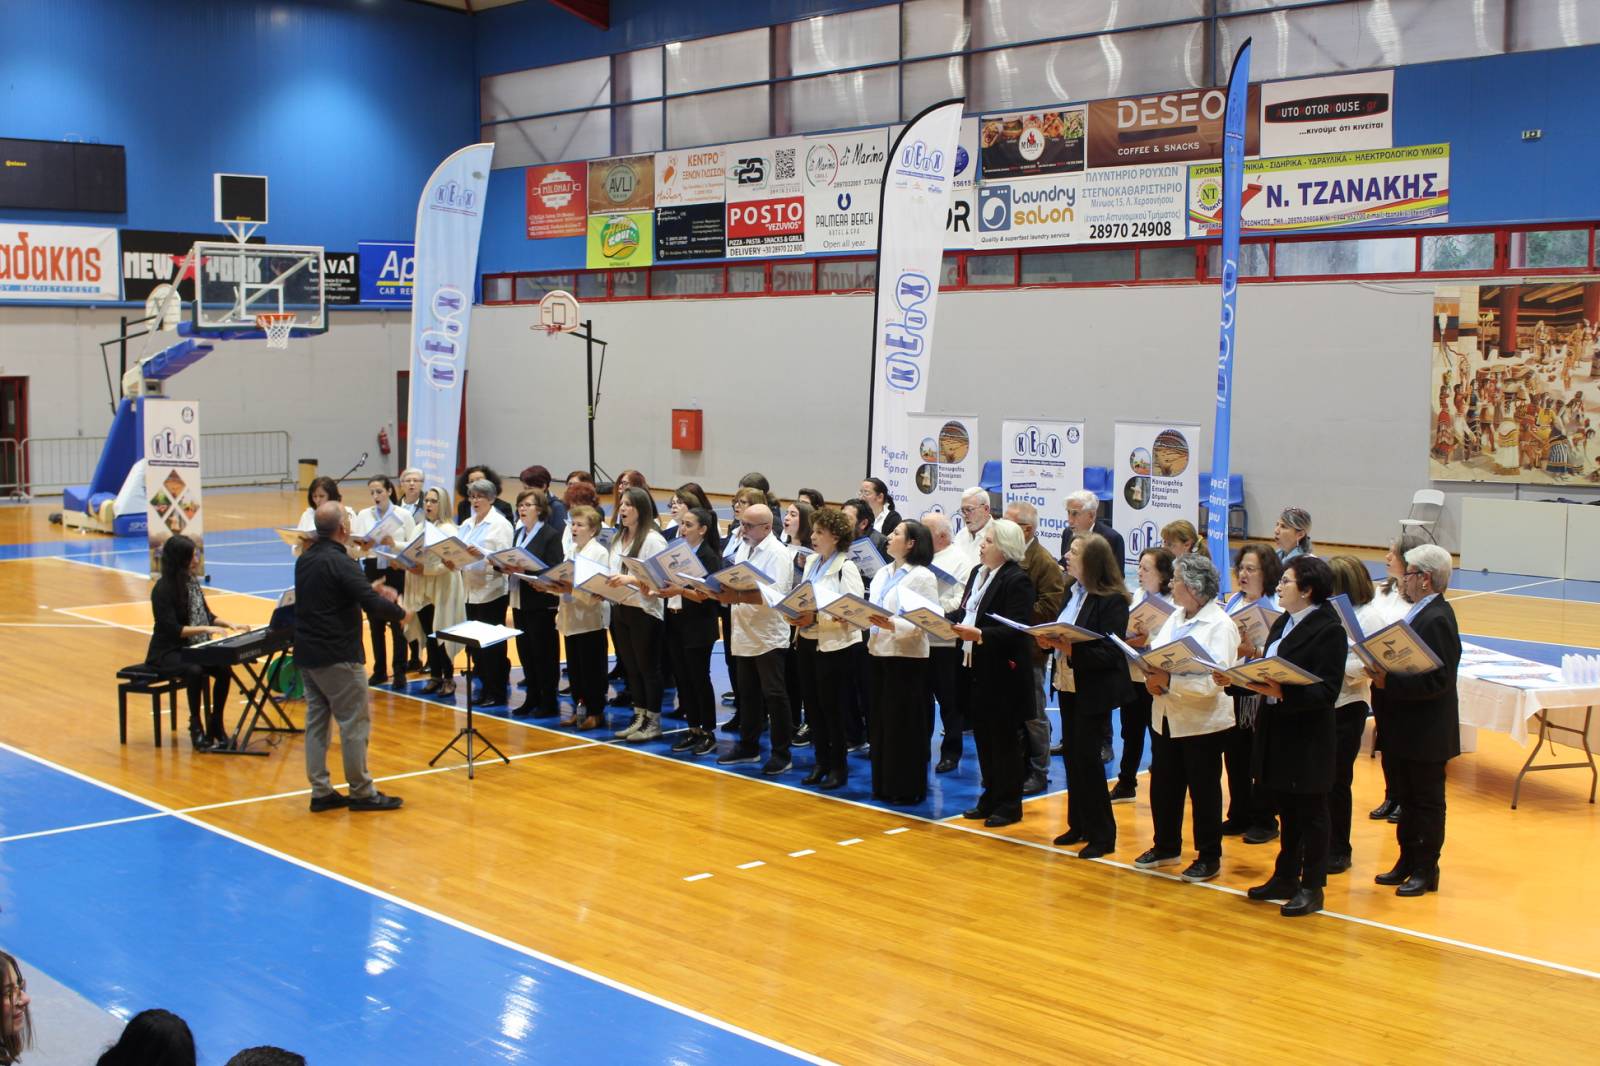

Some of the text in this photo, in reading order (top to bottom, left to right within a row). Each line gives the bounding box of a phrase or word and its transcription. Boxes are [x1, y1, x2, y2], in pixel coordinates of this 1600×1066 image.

[1118, 90, 1226, 129] DESEO
[1118, 142, 1200, 156] COFFEE & SNACKS
[1355, 150, 1419, 161] ΗΛΕΚΤΡΟΛΟΓΙΚΟ
[1420, 147, 1444, 156] ΥΛΙΚΟ
[1086, 166, 1179, 182] ΠΛΥΝΤΗΡΙΟ ΡΟΥΧΩΝ
[609, 176, 632, 193] AVLI
[1298, 173, 1438, 206] ΤΖΑΝΑΚΗΣ
[730, 202, 803, 226] POSTO
[851, 212, 874, 226] BEACH
[1089, 221, 1171, 239] 28970 24908
[730, 247, 761, 257] DELIVERY
[124, 252, 174, 280] NEW
[379, 287, 396, 296] CAR
